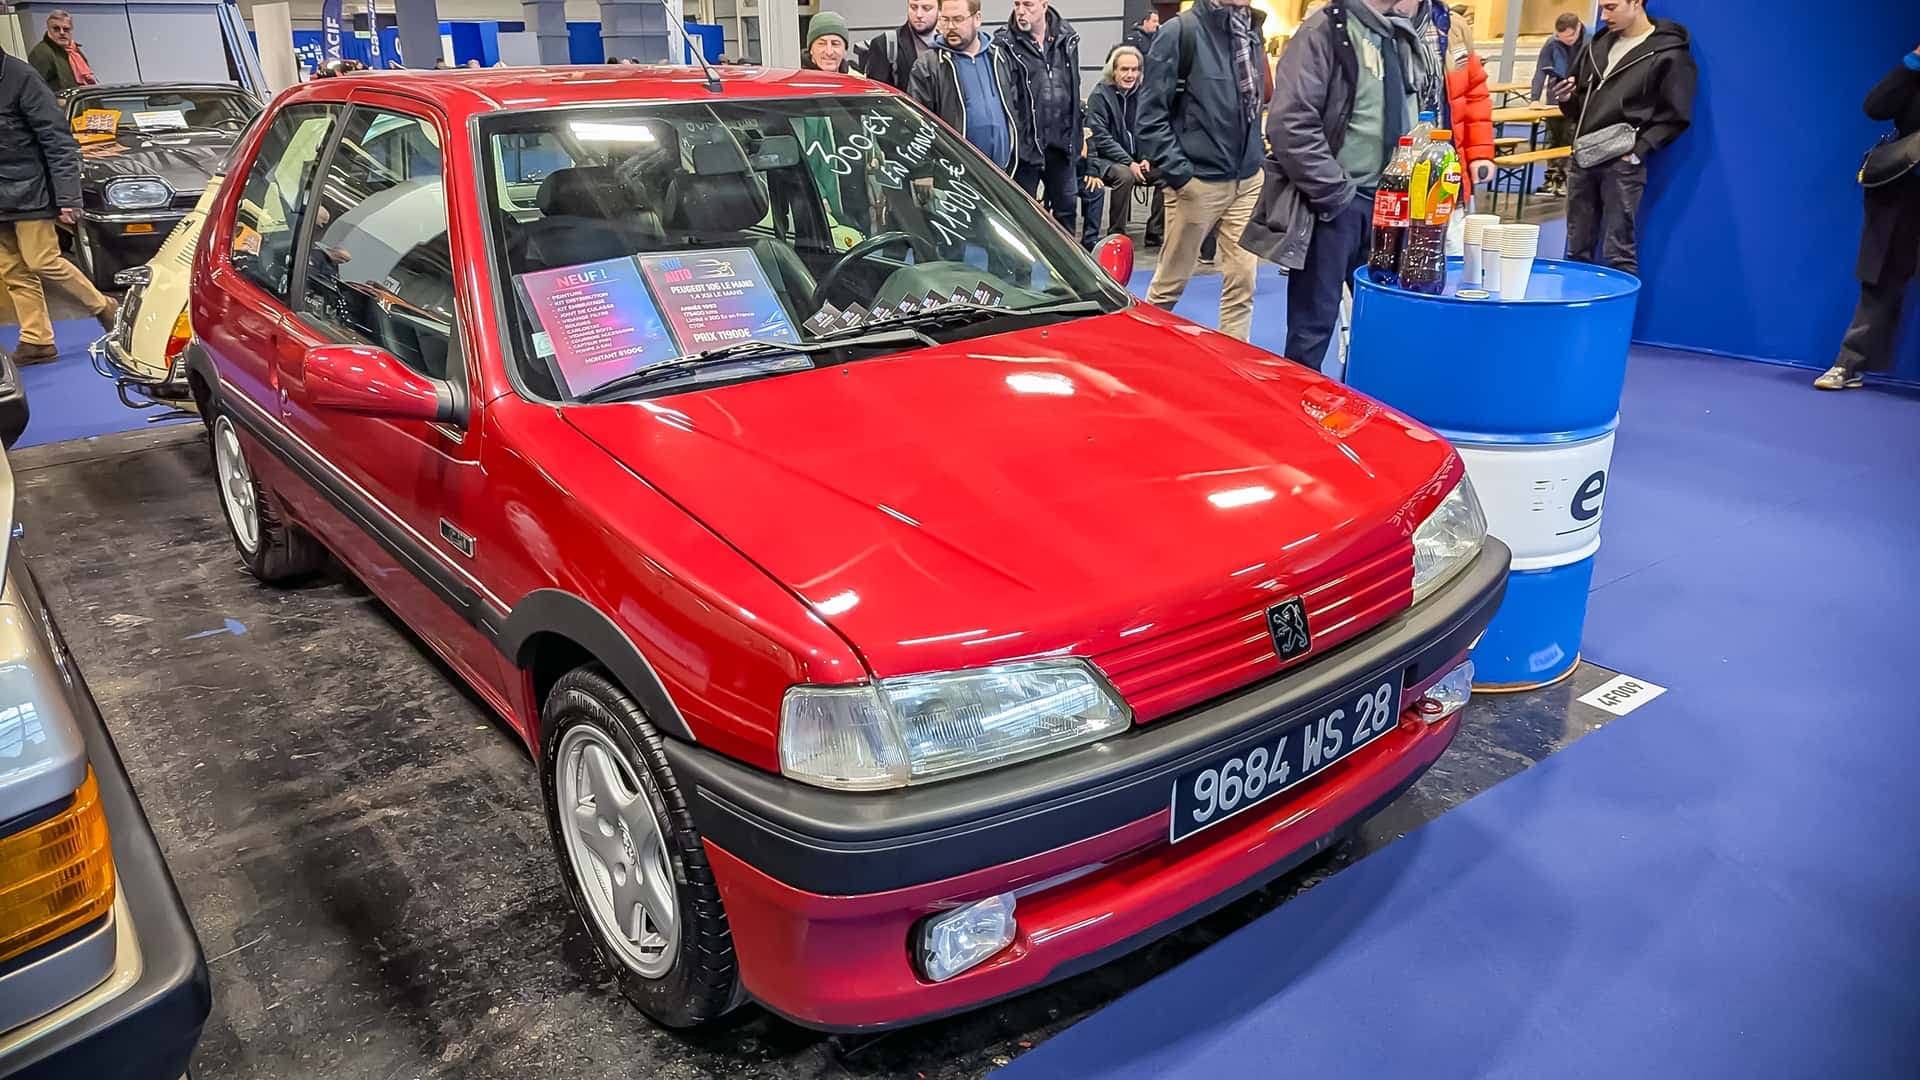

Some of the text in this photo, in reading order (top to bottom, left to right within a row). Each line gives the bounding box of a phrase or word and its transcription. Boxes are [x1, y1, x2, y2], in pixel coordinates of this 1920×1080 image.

[327, 17, 341, 59] ACIF
[881, 160, 911, 186] EN
[556, 270, 598, 288] NEUF
[664, 268, 693, 283] AUTO
[670, 279, 755, 295] PEUGEOT 106 LE MANS
[723, 289, 745, 297] MANS
[693, 331, 719, 343] PRIX
[1597, 681, 1645, 708] 4F009
[1192, 682, 1392, 823] 9684 WS 28
